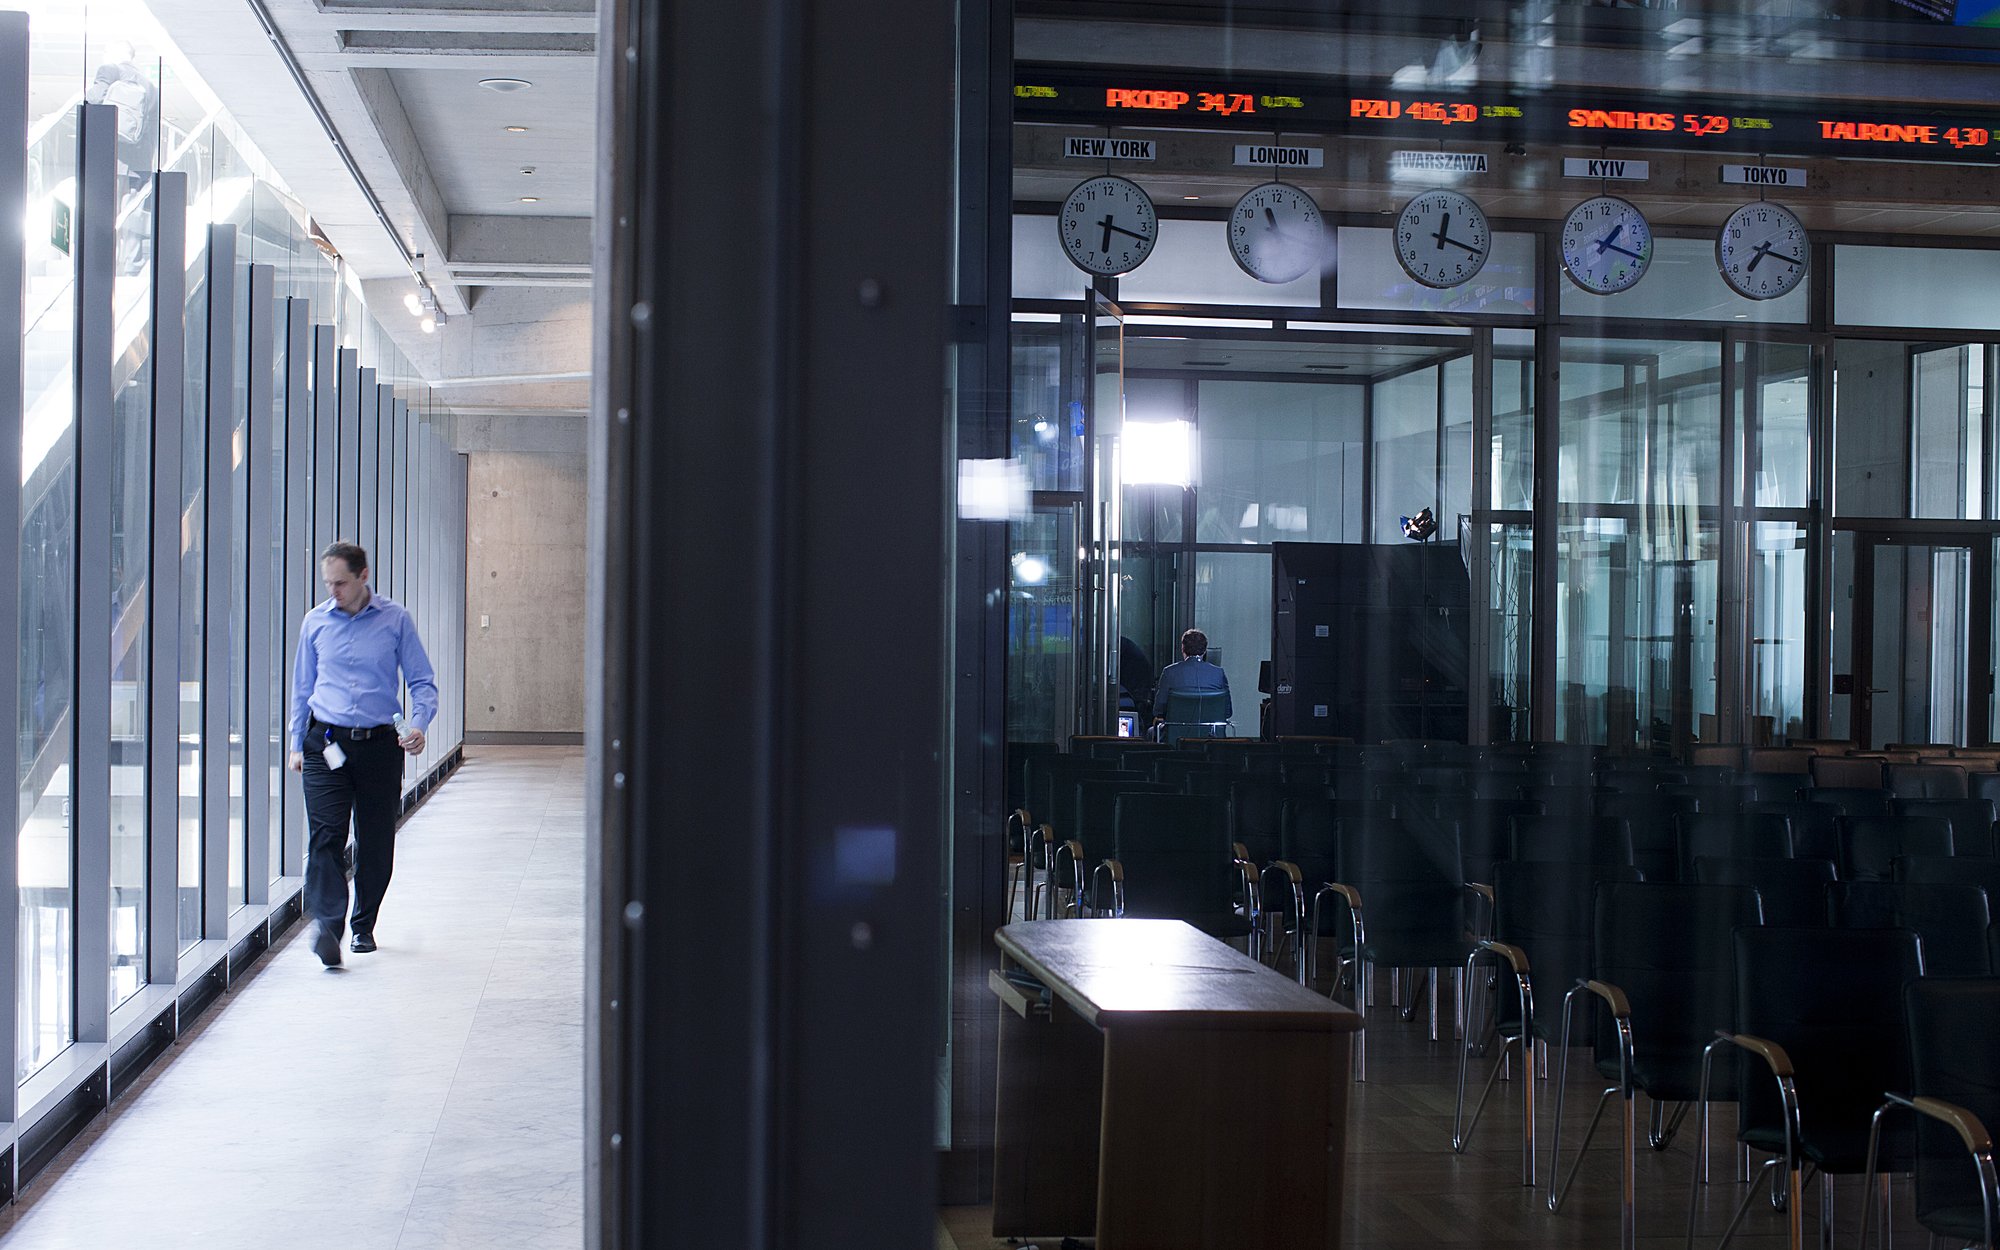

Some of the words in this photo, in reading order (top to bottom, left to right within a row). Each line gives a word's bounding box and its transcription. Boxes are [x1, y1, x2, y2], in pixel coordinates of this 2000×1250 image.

[1196, 92, 1256, 116] 34,71
[1350, 99, 1401, 119] PZU
[1405, 102, 1478, 125] 416,30
[1568, 109, 1676, 131] SYNTHOS
[1683, 114, 1729, 136] 5,29
[1817, 120, 1938, 144] TAURONPE
[1942, 127, 1989, 149] 4,30
[1070, 138, 1105, 156] NEW
[1111, 140, 1151, 158] YORK
[1249, 147, 1309, 165] LONDON
[1402, 152, 1487, 171] WARSZAWA
[1588, 160, 1625, 177] KYIV
[1743, 167, 1787, 184] TOKYO
[1087, 191, 1095, 200] 11
[1104, 186, 1113, 196] 12
[1125, 193, 1128, 202] 1
[1272, 193, 1282, 203] 12
[1256, 198, 1264, 207] 11
[1293, 200, 1296, 209] 1
[1438, 200, 1447, 209] 12
[1076, 203, 1085, 212] 10
[1137, 205, 1142, 214] 2
[1421, 204, 1429, 213] 11
[1458, 206, 1461, 215] 1
[1601, 206, 1610, 215] 12
[1244, 209, 1253, 218] 10
[1305, 213, 1309, 222] 2
[1585, 211, 1592, 220] 11
[1621, 213, 1624, 222] 1
[1758, 213, 1767, 222] 12
[1410, 216, 1419, 225] 10
[1469, 219, 1475, 228] 2
[1742, 218, 1750, 226] 11
[1777, 219, 1780, 227] 1
[1070, 221, 1076, 230] 9
[1141, 223, 1146, 232] 3
[1574, 223, 1583, 231] 10
[1632, 225, 1637, 234] 2
[1240, 227, 1245, 236] 9
[1732, 230, 1740, 238] 10
[1788, 231, 1793, 239] 2
[1406, 233, 1411, 242] 9
[1473, 235, 1479, 244] 3
[1075, 239, 1081, 248] 8
[1135, 241, 1141, 249] 4
[1570, 240, 1575, 248] 9
[1636, 242, 1641, 251] 3
[1244, 245, 1249, 254] 8
[1728, 246, 1734, 255] 9
[1793, 247, 1798, 256] 3
[1089, 252, 1094, 261] 7
[1123, 253, 1129, 261] 5
[1410, 251, 1416, 260] 8
[1468, 253, 1473, 262] 4
[1105, 257, 1111, 266] 6
[1574, 257, 1579, 266] 8
[1631, 260, 1636, 268] 4
[1423, 264, 1428, 273] 7
[1439, 268, 1445, 278] 6
[1456, 265, 1462, 274] 5
[1733, 264, 1738, 273] 8
[1788, 265, 1793, 273] 4
[1587, 270, 1592, 278] 7
[1620, 271, 1624, 280] 5
[1603, 275, 1608, 284] 6
[1746, 276, 1751, 285] 7
[1777, 276, 1782, 285] 5
[1761, 281, 1767, 290] 6
